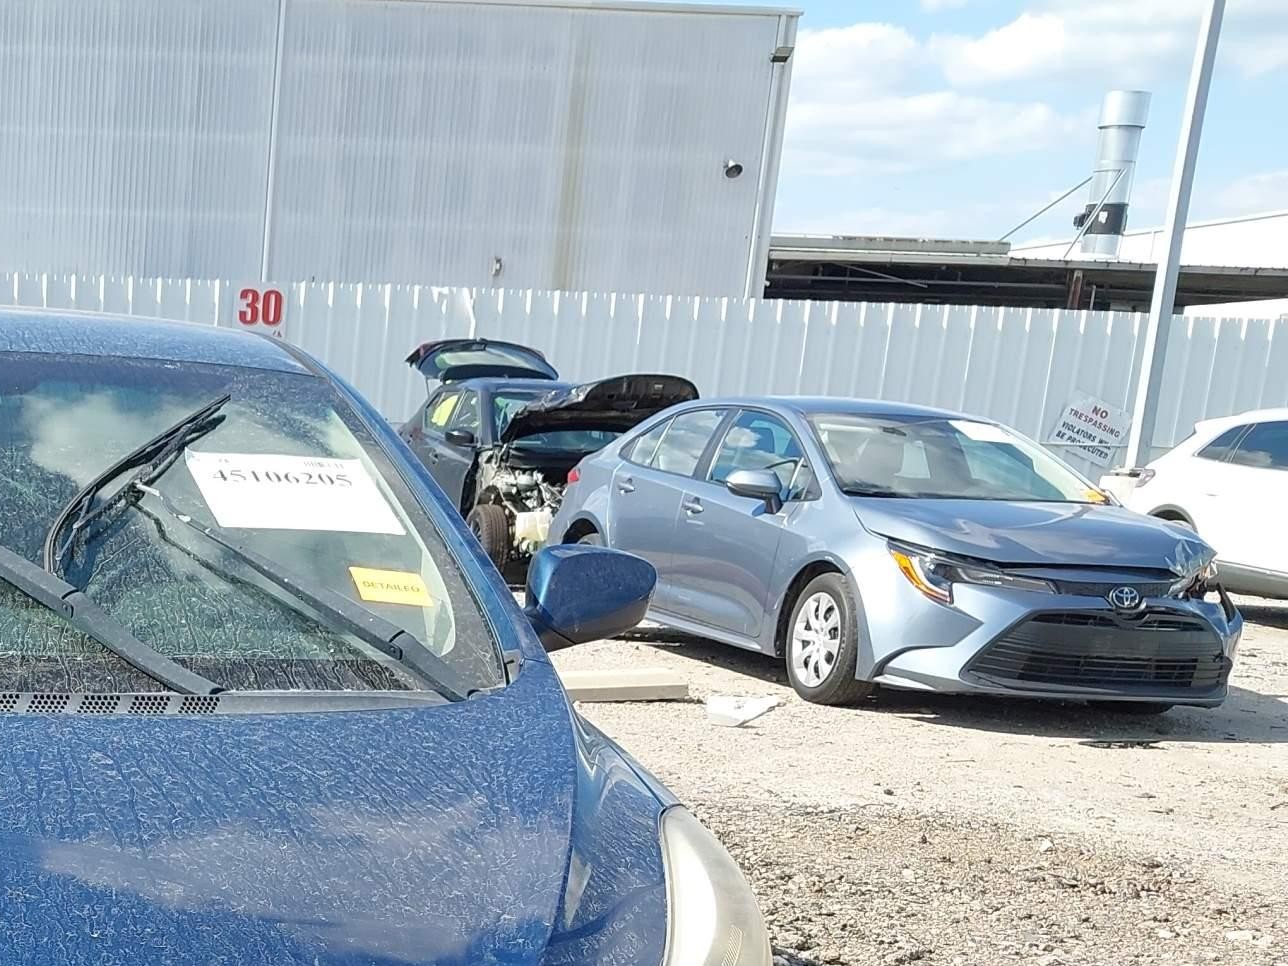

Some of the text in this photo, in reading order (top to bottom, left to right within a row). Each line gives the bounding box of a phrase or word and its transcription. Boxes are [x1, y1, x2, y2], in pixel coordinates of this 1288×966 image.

[239, 288, 282, 325] 30
[1091, 405, 1109, 419] NO
[1062, 420, 1097, 442] VIOLATORS
[1068, 407, 1121, 438] TRESPASSING
[1056, 430, 1067, 440] BE
[212, 469, 353, 487] 45106205
